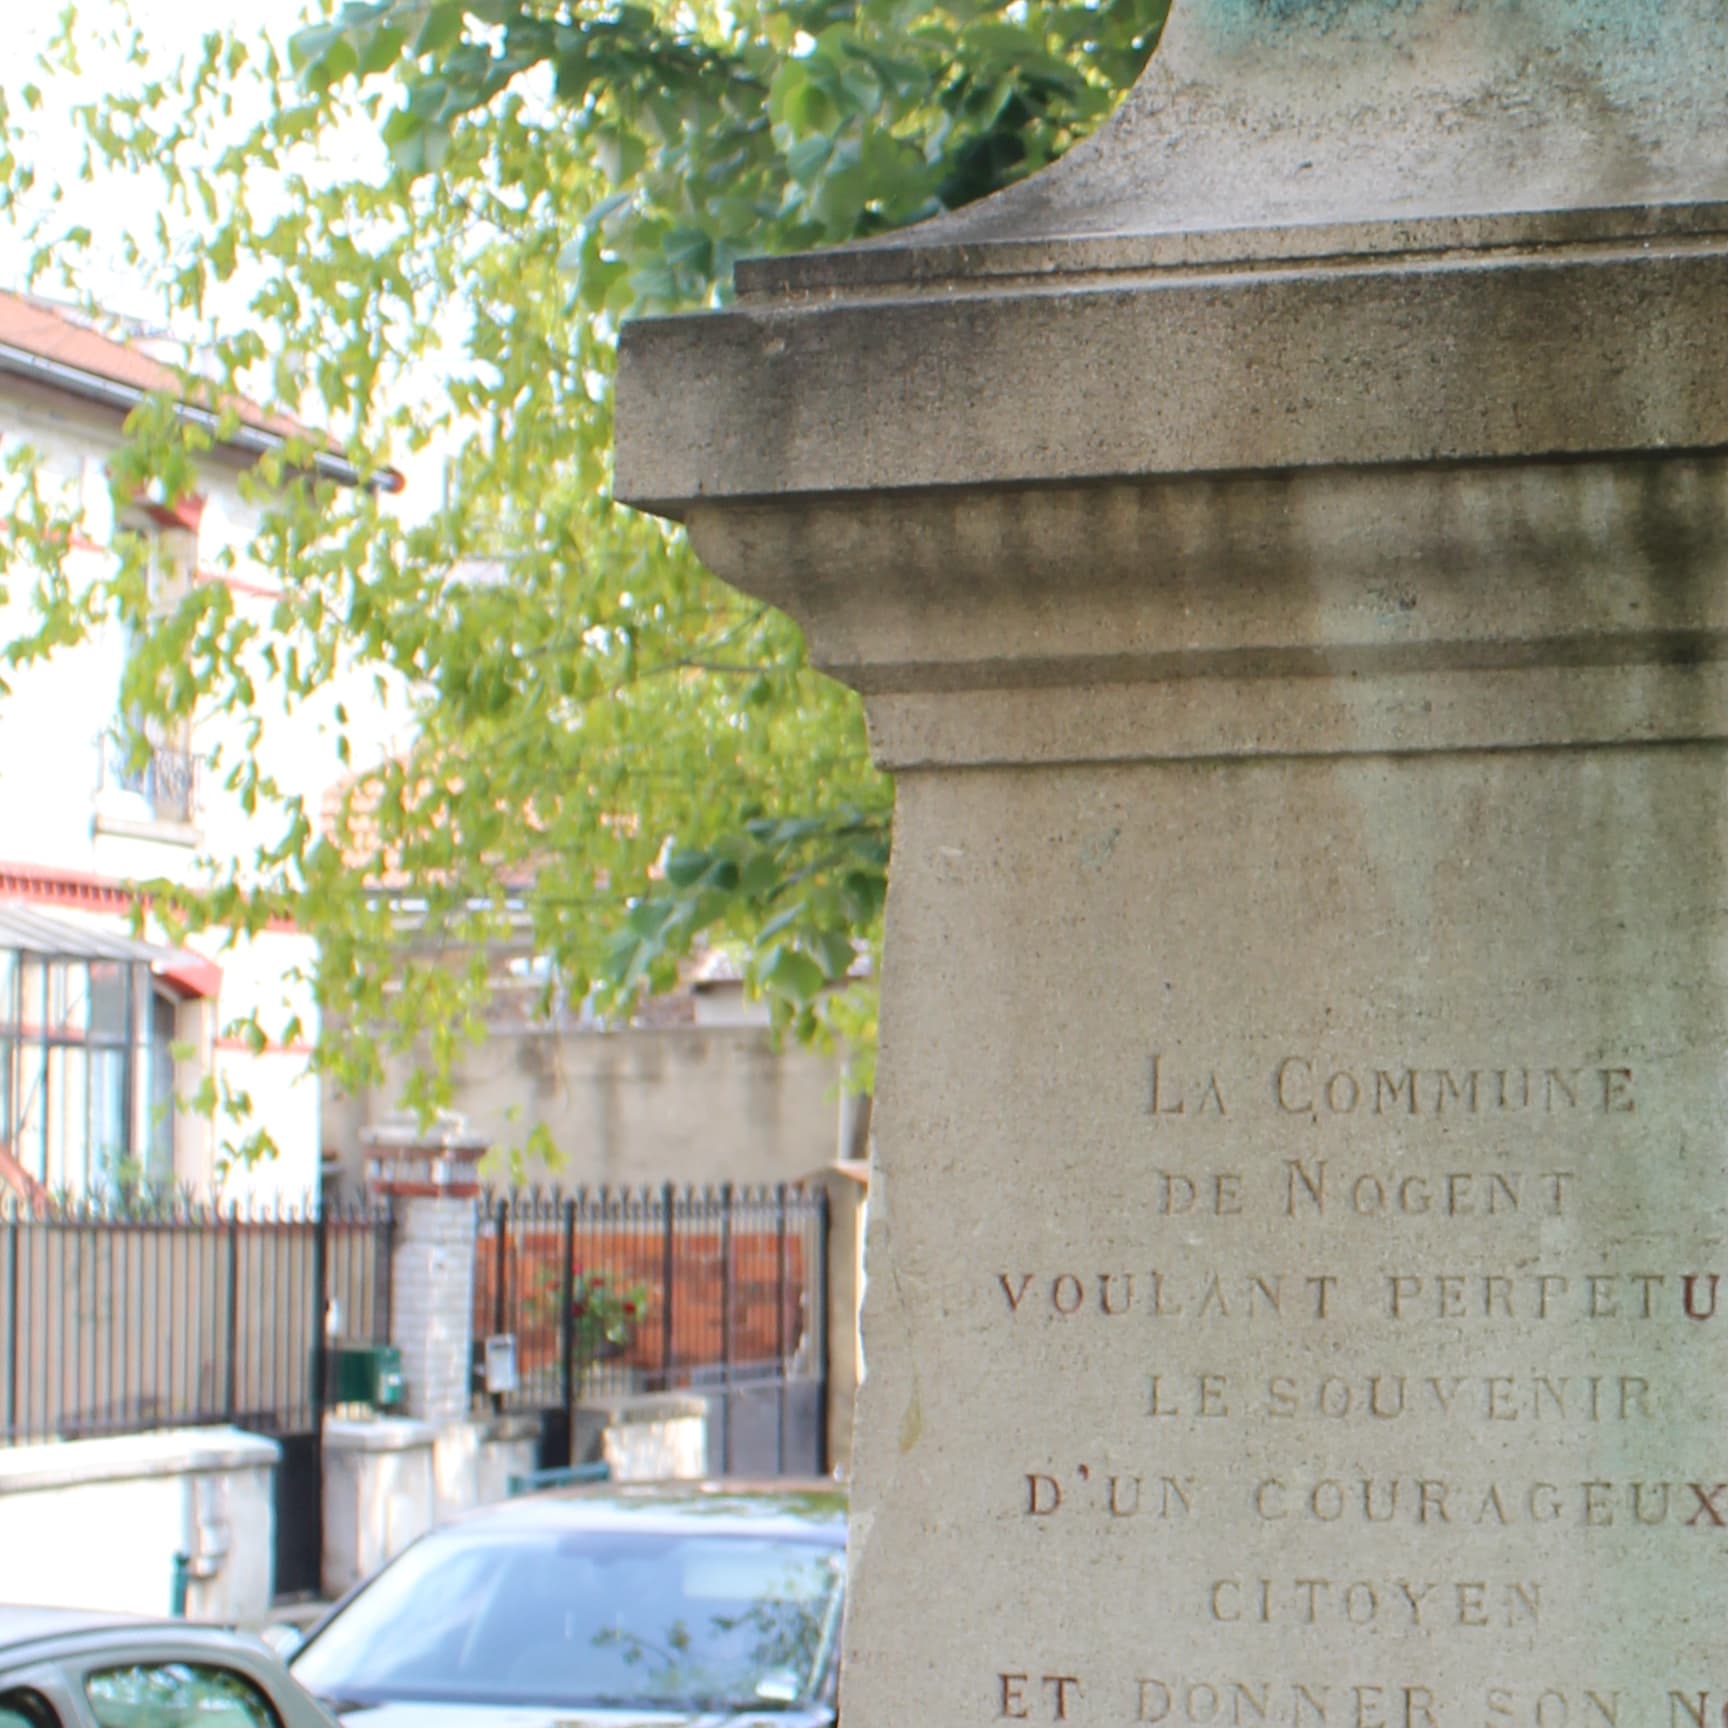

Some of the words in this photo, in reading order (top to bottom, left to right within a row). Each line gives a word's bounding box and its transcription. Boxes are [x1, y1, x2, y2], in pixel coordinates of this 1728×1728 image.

[1158, 1172, 1246, 1217] DE
[999, 1272, 1338, 1320] VOULANT
[1148, 1374, 1230, 1418] LE
[1266, 1375, 1656, 1422] SOUVENIR
[1025, 1465, 1196, 1520] D'UN
[1208, 1578, 1546, 1627] CITOYEN
[998, 1674, 1080, 1722] ET
